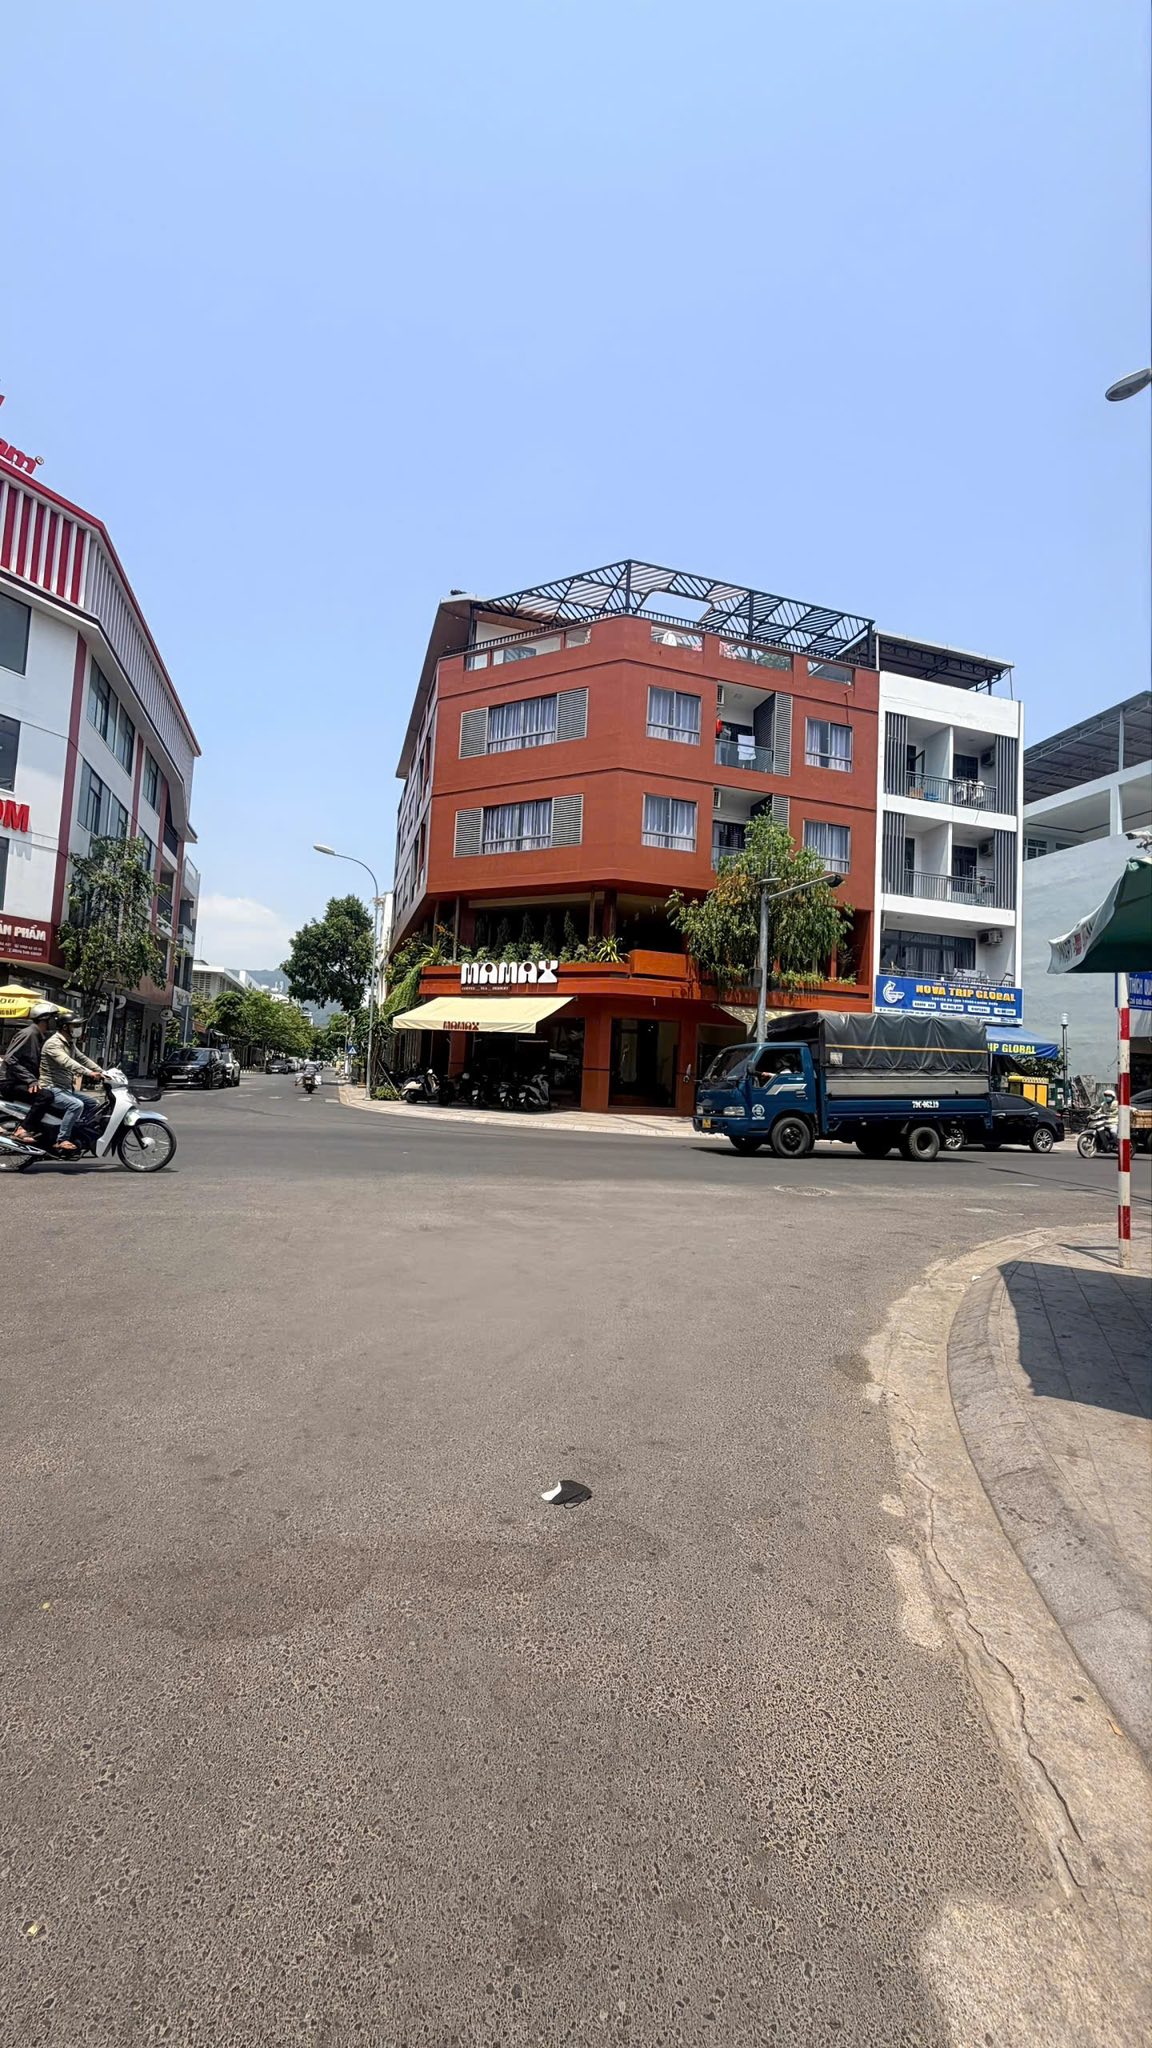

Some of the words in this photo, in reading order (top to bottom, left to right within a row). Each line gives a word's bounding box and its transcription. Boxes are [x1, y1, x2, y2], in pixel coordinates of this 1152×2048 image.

[0, 799, 30, 832] M
[461, 959, 559, 984] MAMAX
[915, 985, 946, 996] NOVA
[948, 988, 974, 998] TRIP
[975, 990, 1016, 1002] GLOBAL
[443, 1021, 480, 1030] MAMAX
[1002, 1043, 1037, 1055] GLOBAL
